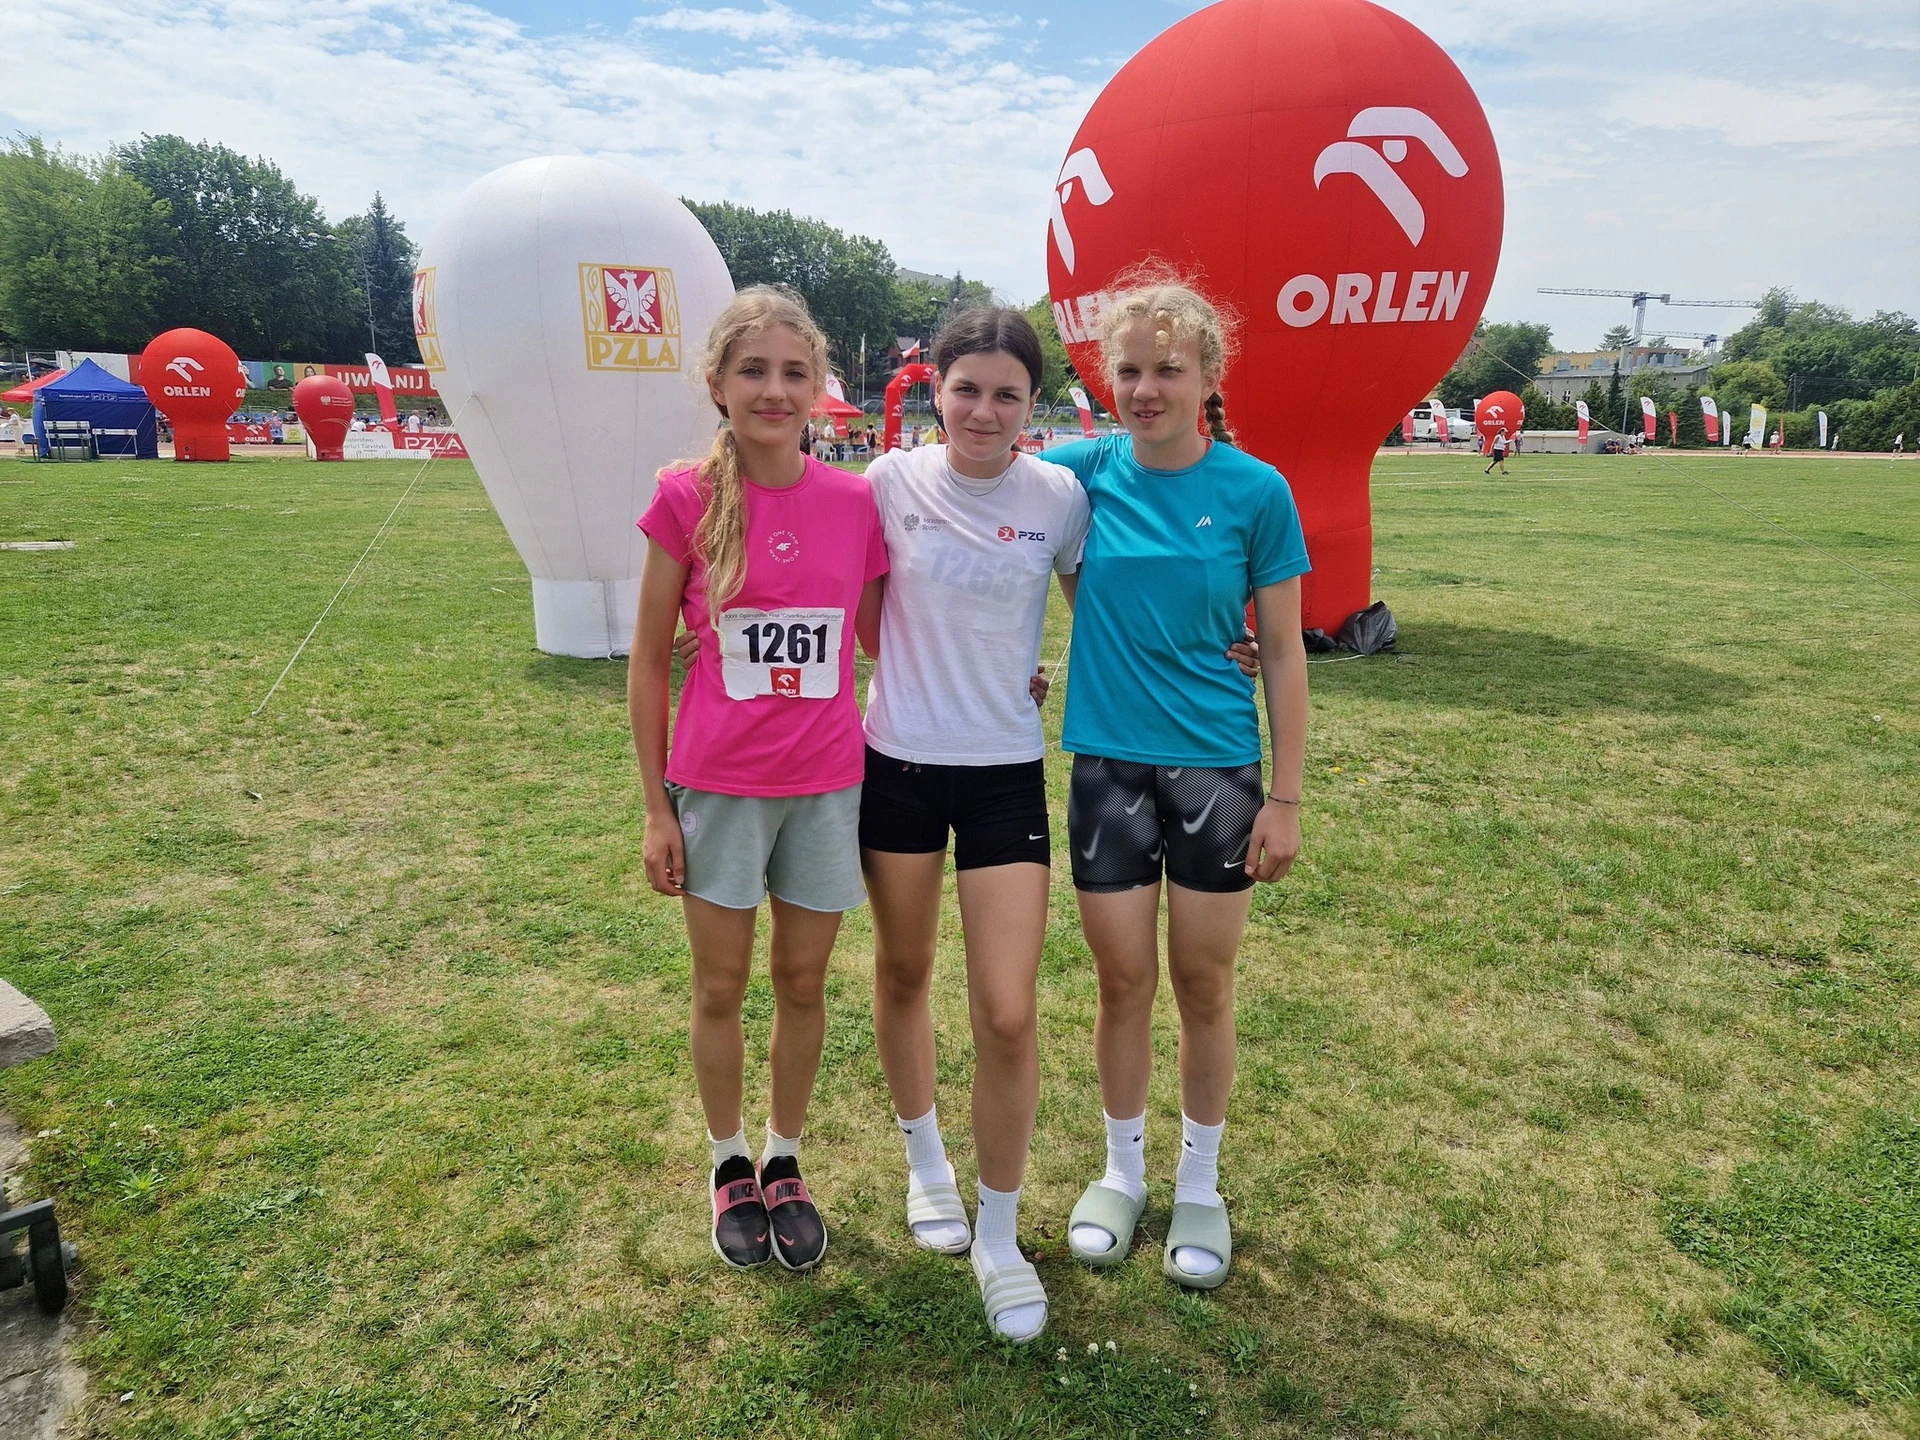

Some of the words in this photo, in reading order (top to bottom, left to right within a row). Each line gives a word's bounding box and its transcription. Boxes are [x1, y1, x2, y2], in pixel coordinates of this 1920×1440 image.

[1276, 270, 1469, 328] ORLEN
[591, 336, 677, 367] PZLA
[337, 371, 424, 390] UWNIJ
[163, 385, 211, 398] ORLEN
[404, 437, 463, 451] PZLA
[1018, 530, 1046, 542] PZG
[776, 542, 792, 551] 4F
[742, 622, 828, 664] 1261
[729, 1182, 754, 1203] NIKE
[776, 1181, 800, 1202] NIKE
